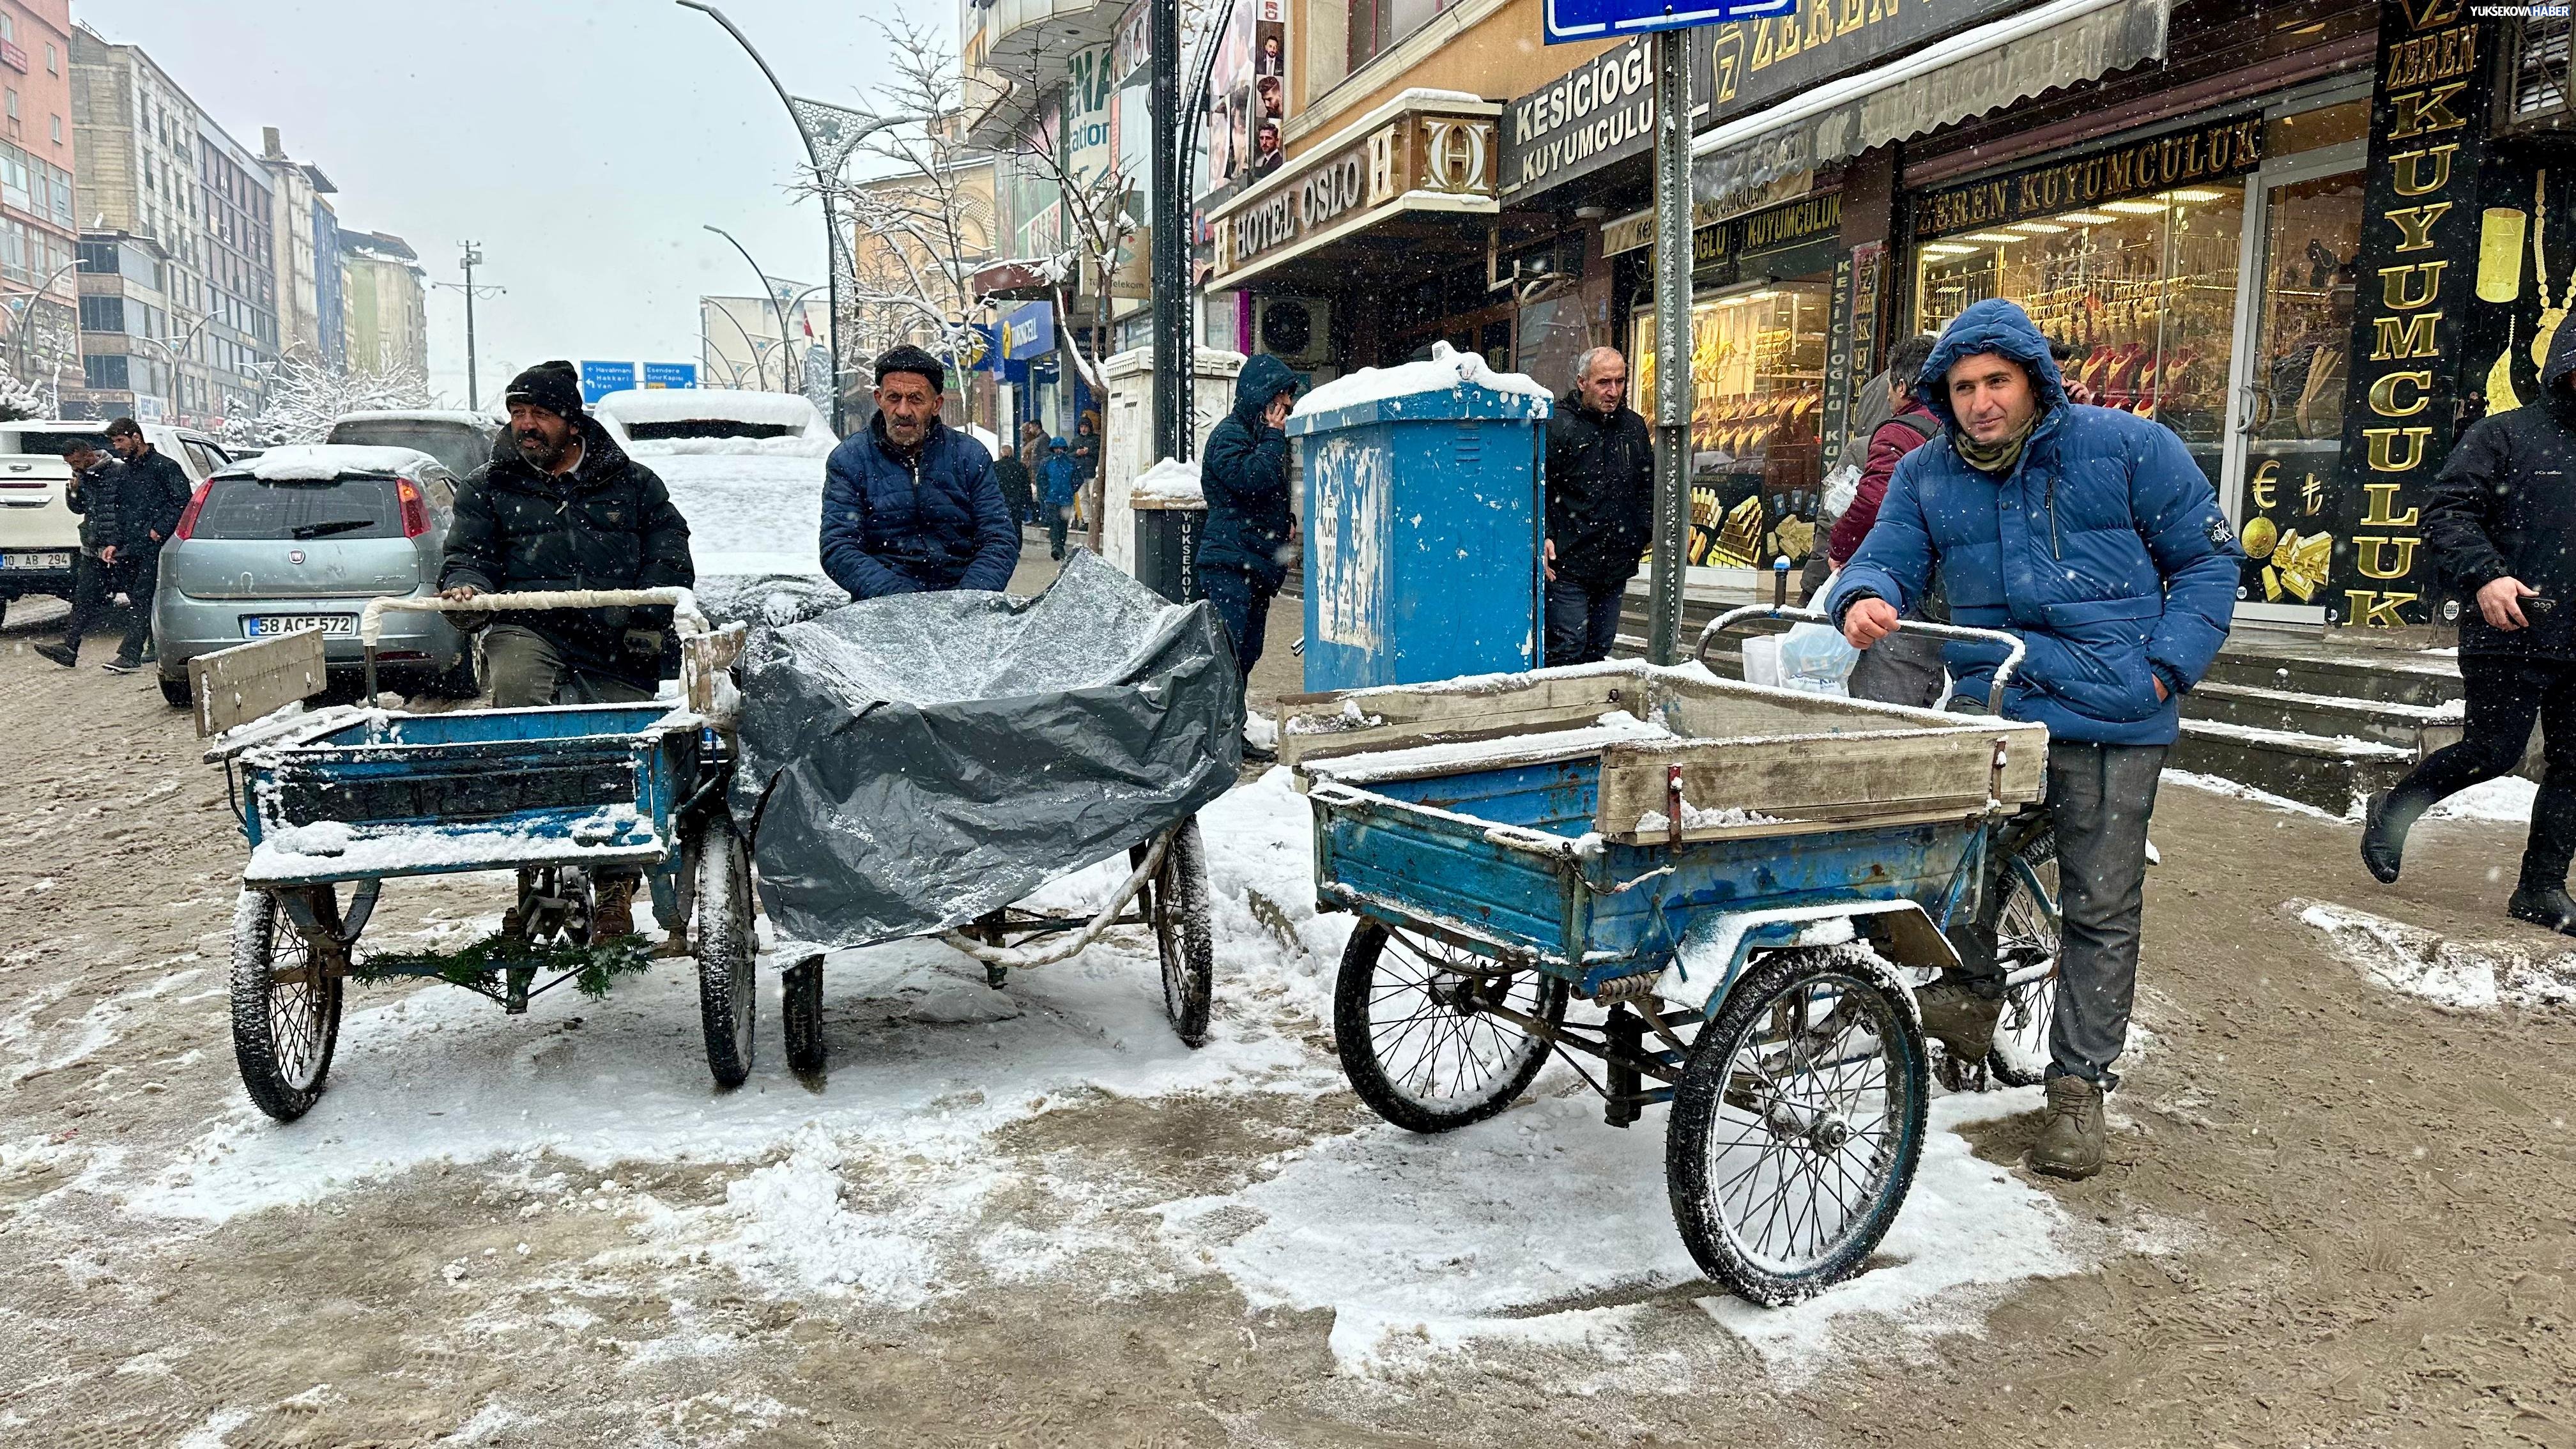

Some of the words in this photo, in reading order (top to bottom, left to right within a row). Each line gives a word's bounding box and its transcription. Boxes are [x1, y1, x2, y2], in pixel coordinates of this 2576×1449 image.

[1516, 34, 1653, 146] KESİCİOĞL
[2386, 23, 2478, 91] ZEREN
[1522, 97, 1653, 184] KUYUMCULU
[1917, 180, 2009, 234] ZEREN
[2018, 118, 2262, 214] KUYUMCULUK
[1234, 192, 1294, 261] HOTEL
[1300, 153, 1361, 229] OSLO
[1747, 193, 1843, 247] KUYUMCULUK
[1112, 279, 1144, 289] elekom
[2342, 80, 2468, 629] KUYUMCULUK
[4, 555, 14, 565] 10
[26, 555, 38, 565] AB
[48, 554, 67, 565] 294
[259, 618, 279, 632] 58
[319, 617, 349, 631] 572
